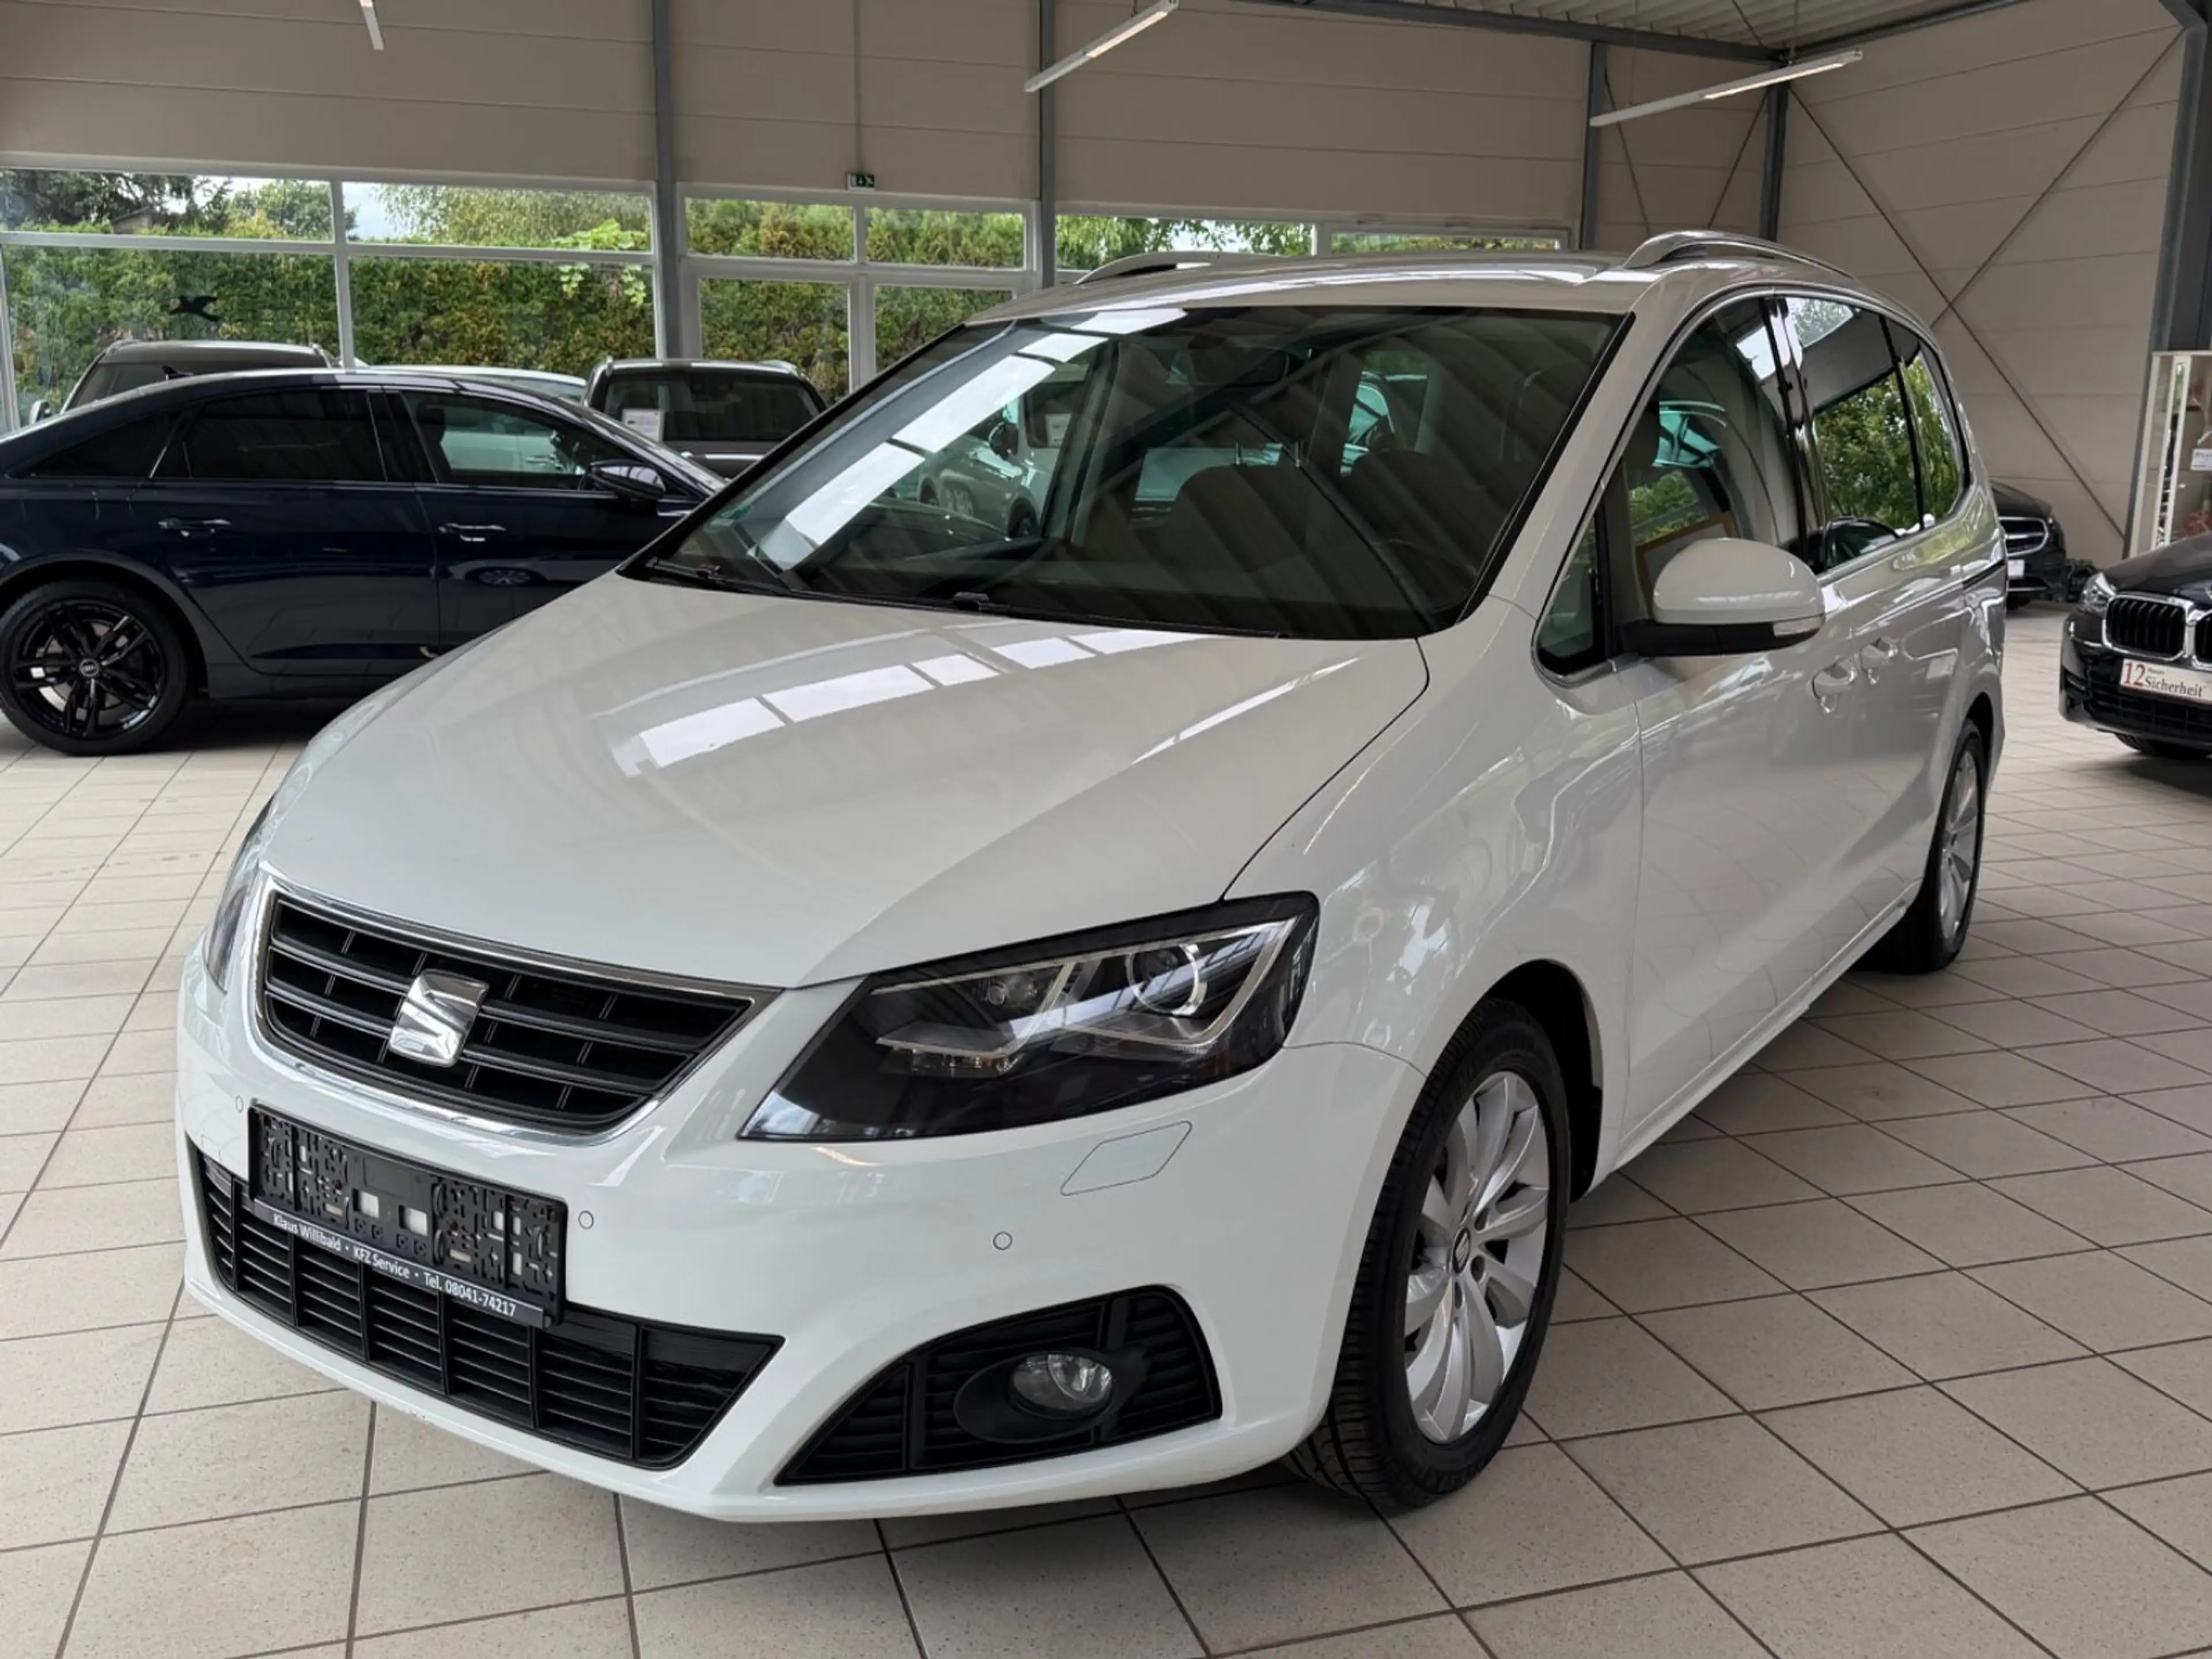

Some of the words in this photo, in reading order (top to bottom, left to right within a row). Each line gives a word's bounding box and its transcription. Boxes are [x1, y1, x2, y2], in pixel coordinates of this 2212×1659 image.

[2124, 662, 2146, 687] 12
[2145, 676, 2203, 696] Sicherheit
[274, 1213, 298, 1234] Klaus
[299, 1223, 342, 1251] Willibald
[353, 1246, 371, 1264] KFZ
[373, 1253, 410, 1279] Service
[423, 1272, 442, 1290] Tel.
[445, 1280, 516, 1316] 08041-74217
